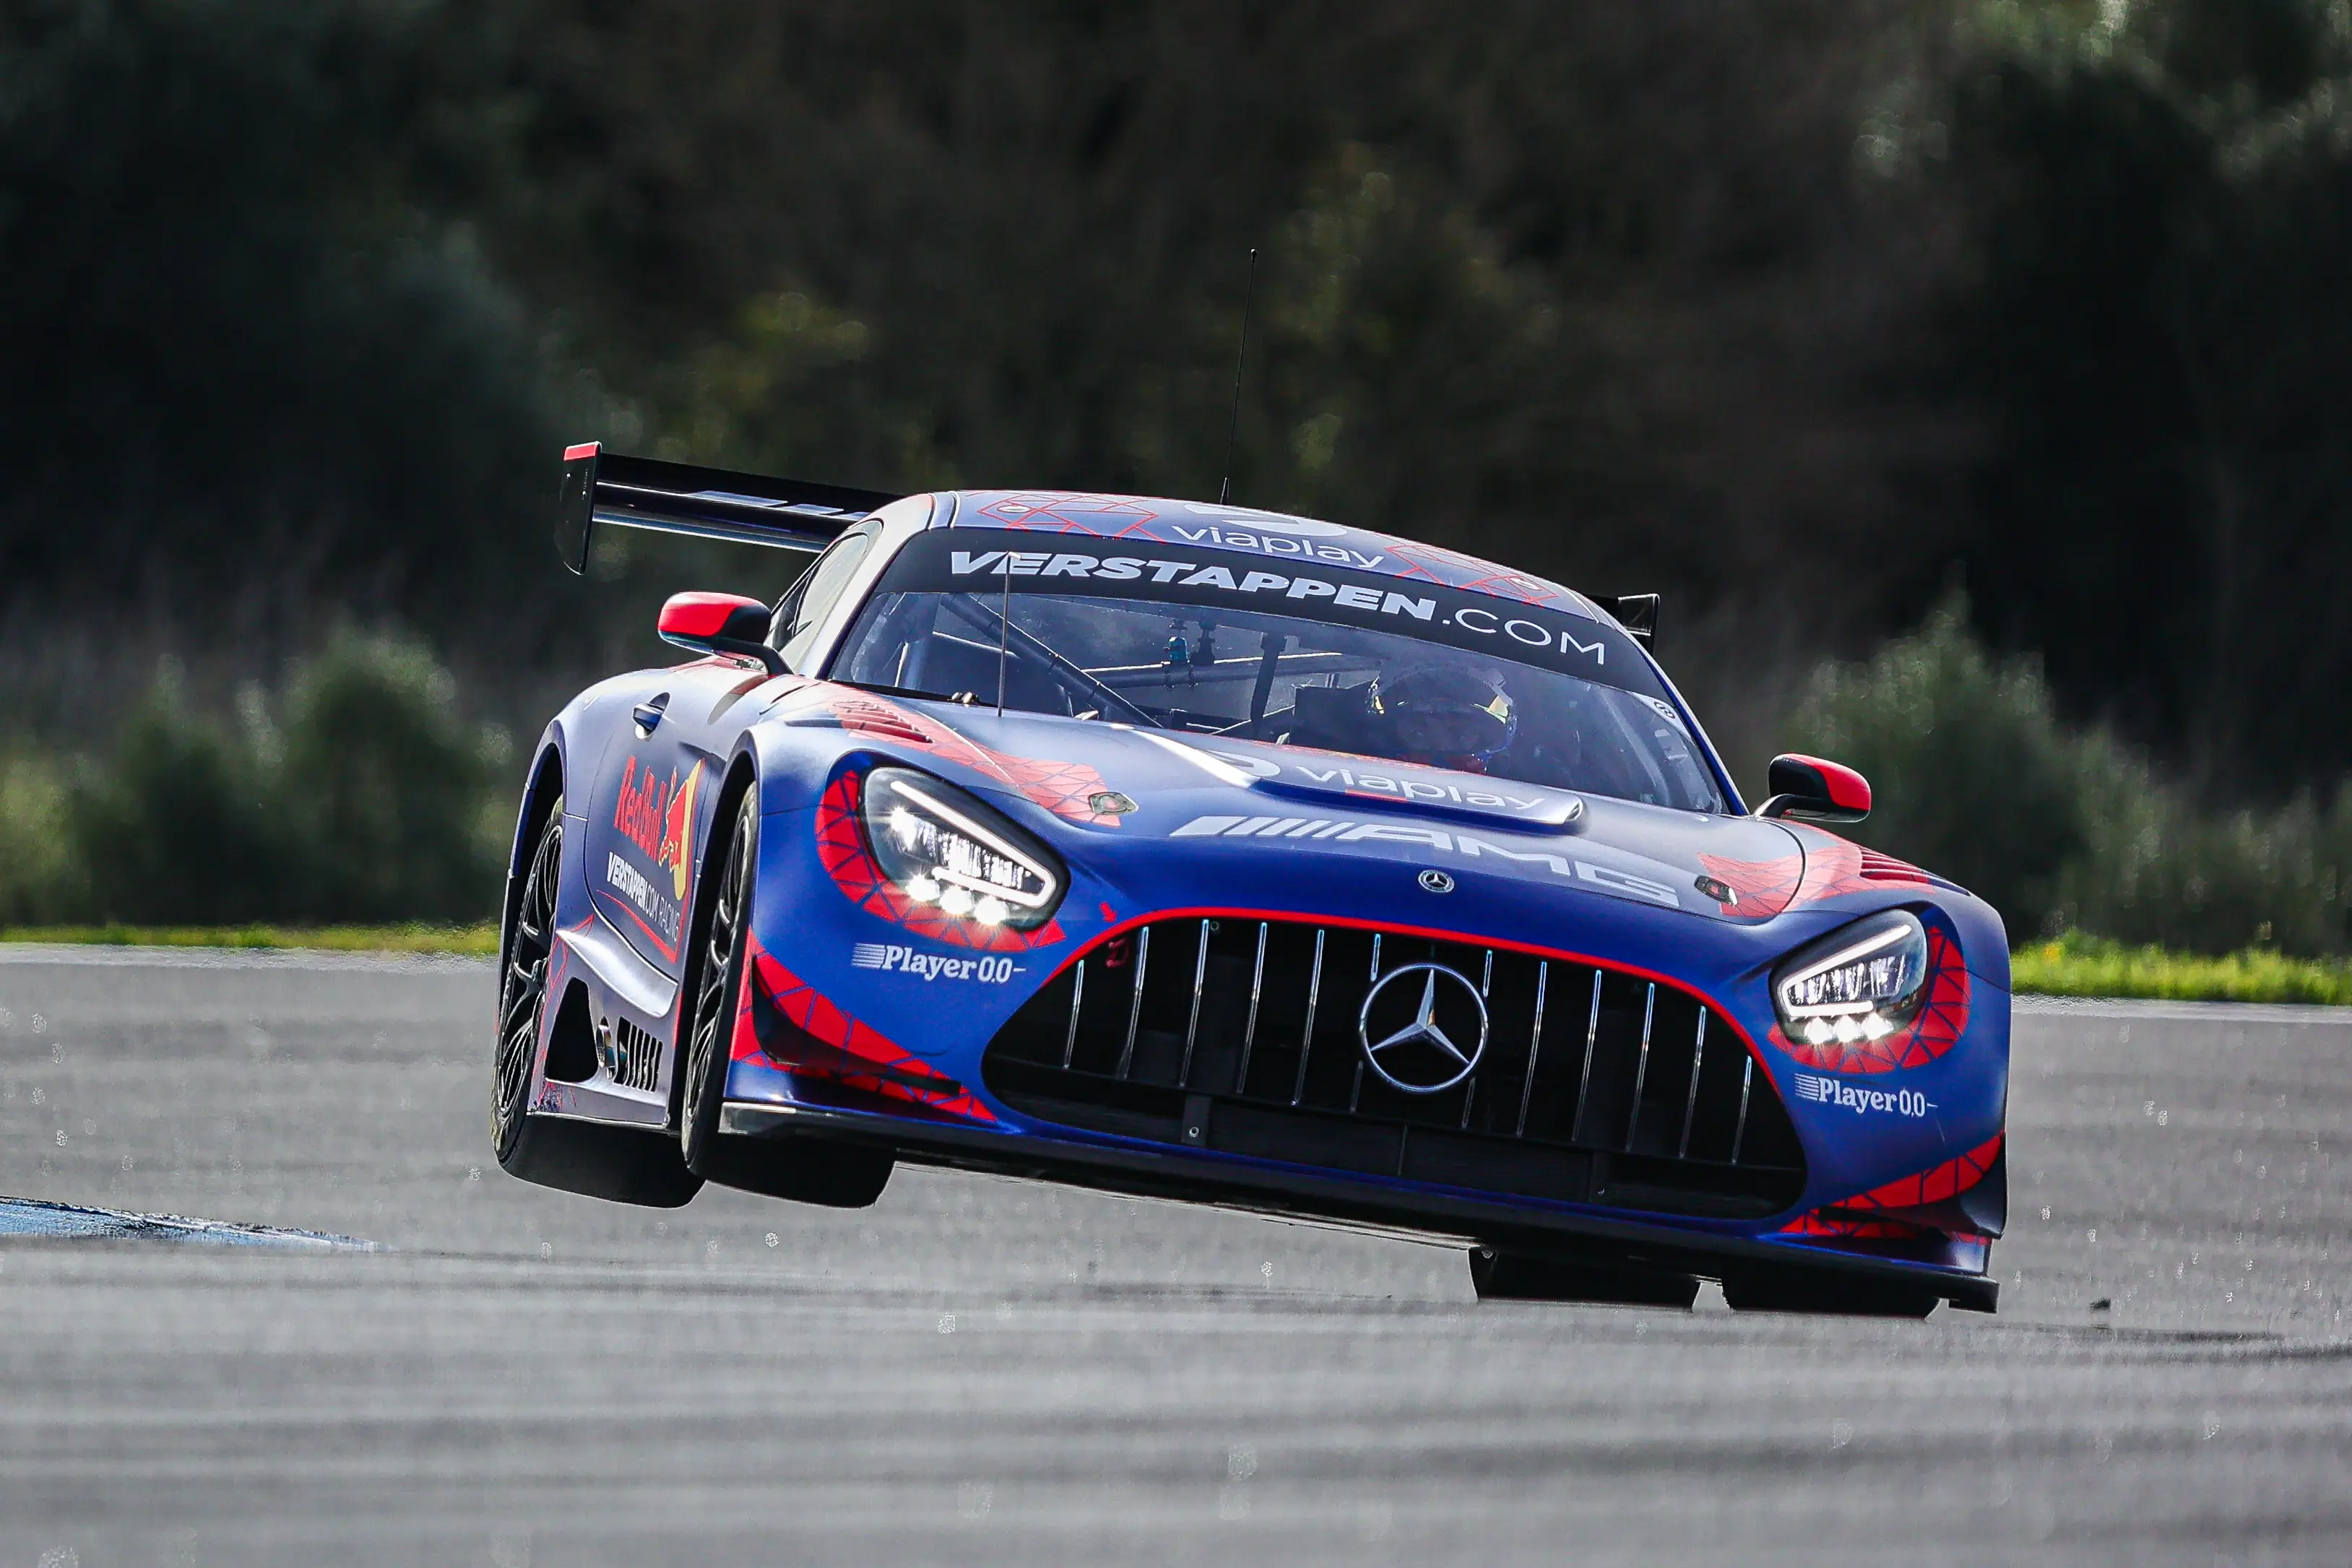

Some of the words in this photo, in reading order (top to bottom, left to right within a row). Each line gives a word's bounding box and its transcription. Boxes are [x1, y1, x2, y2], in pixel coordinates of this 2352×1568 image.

[1171, 525, 1385, 568] viaplay
[951, 551, 1604, 665] VERSTAPPEN.COM
[1294, 766, 1547, 810] viaplay
[1336, 824, 1681, 907] AMG
[606, 851, 660, 922] VERSTAPPEN.COM
[658, 895, 681, 942] RACING
[882, 945, 977, 982] Player
[1817, 1077, 1898, 1114] Player
